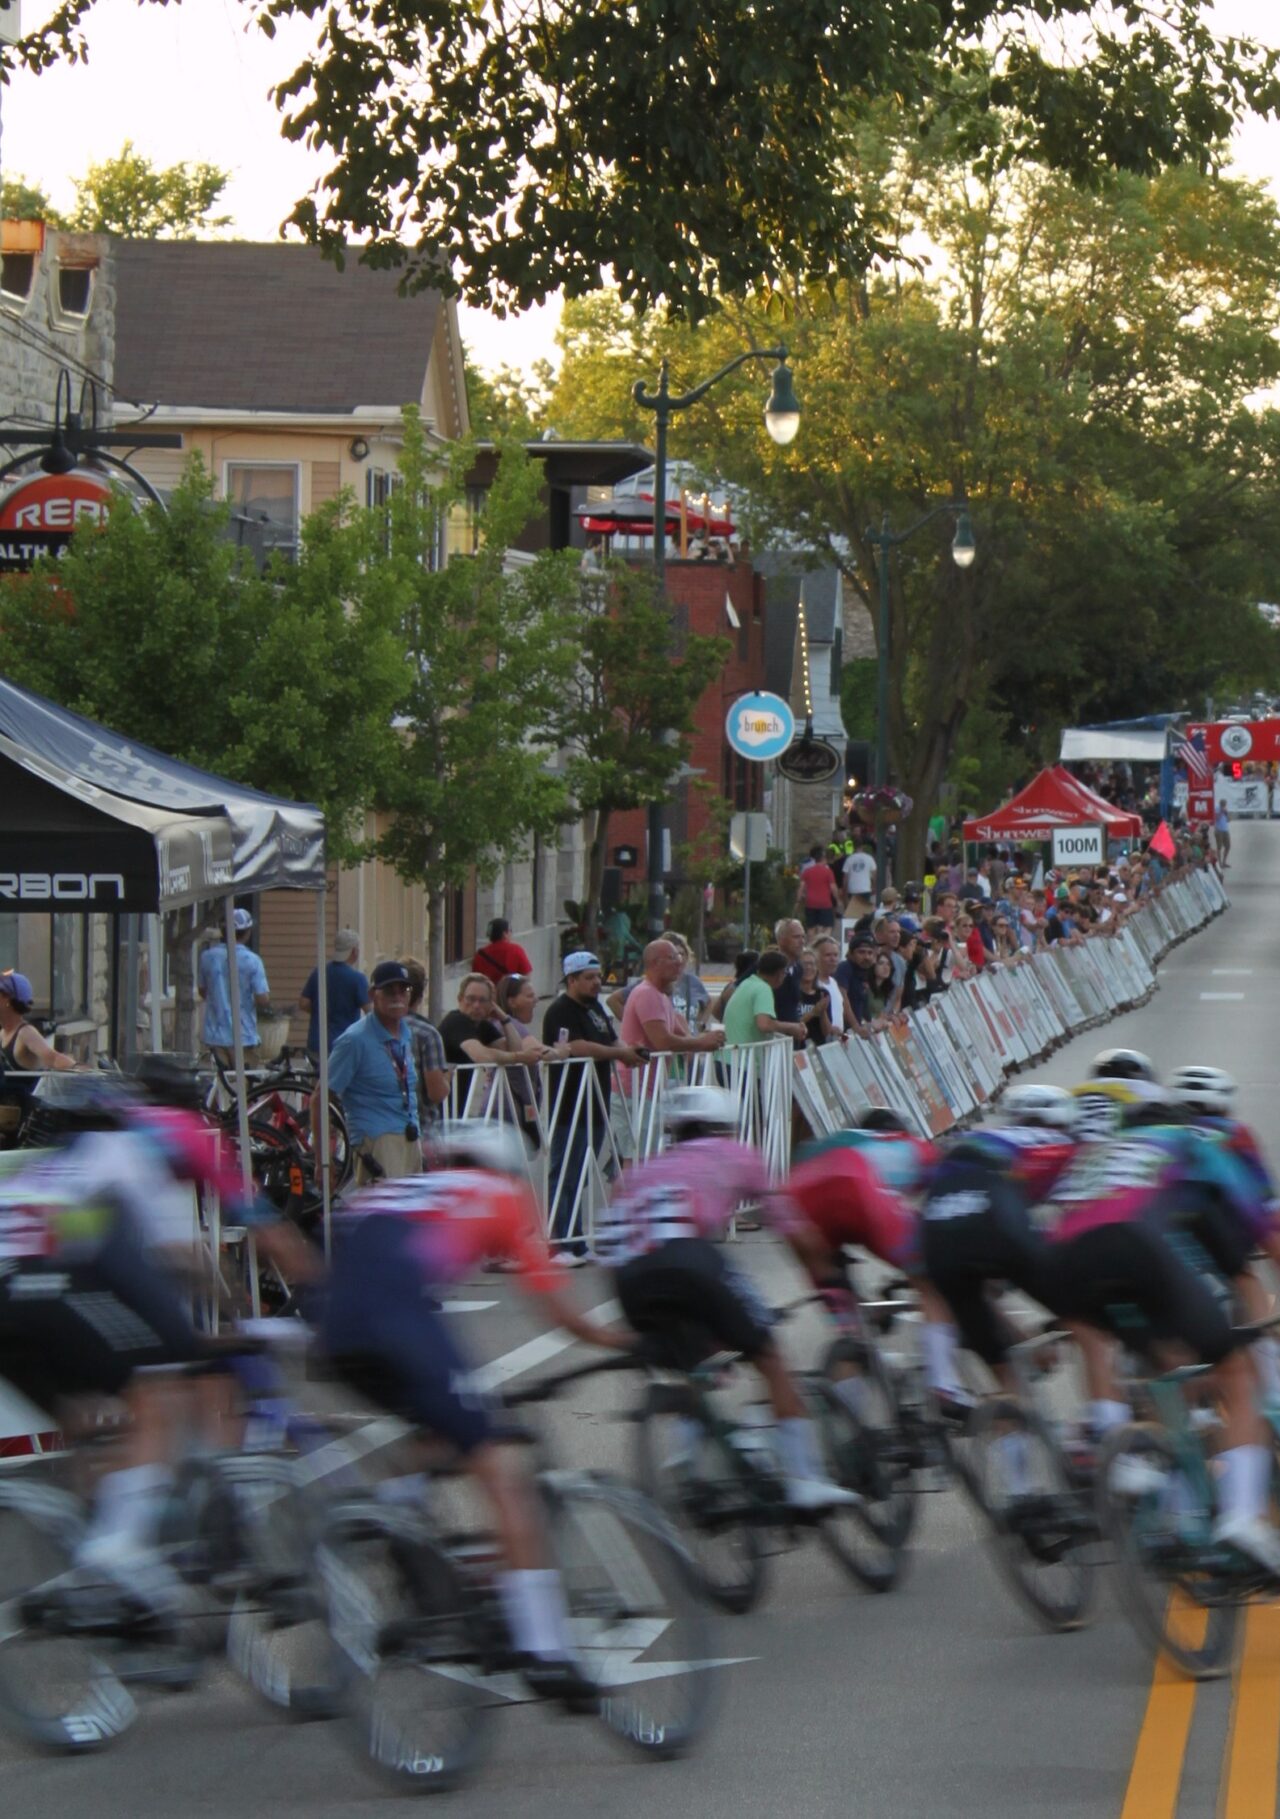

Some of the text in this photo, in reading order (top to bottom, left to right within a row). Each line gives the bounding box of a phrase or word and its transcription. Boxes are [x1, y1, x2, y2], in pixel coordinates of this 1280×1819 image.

[744, 717, 778, 733] brunch
[1232, 761, 1242, 781] 5
[1058, 838, 1099, 854] 100M
